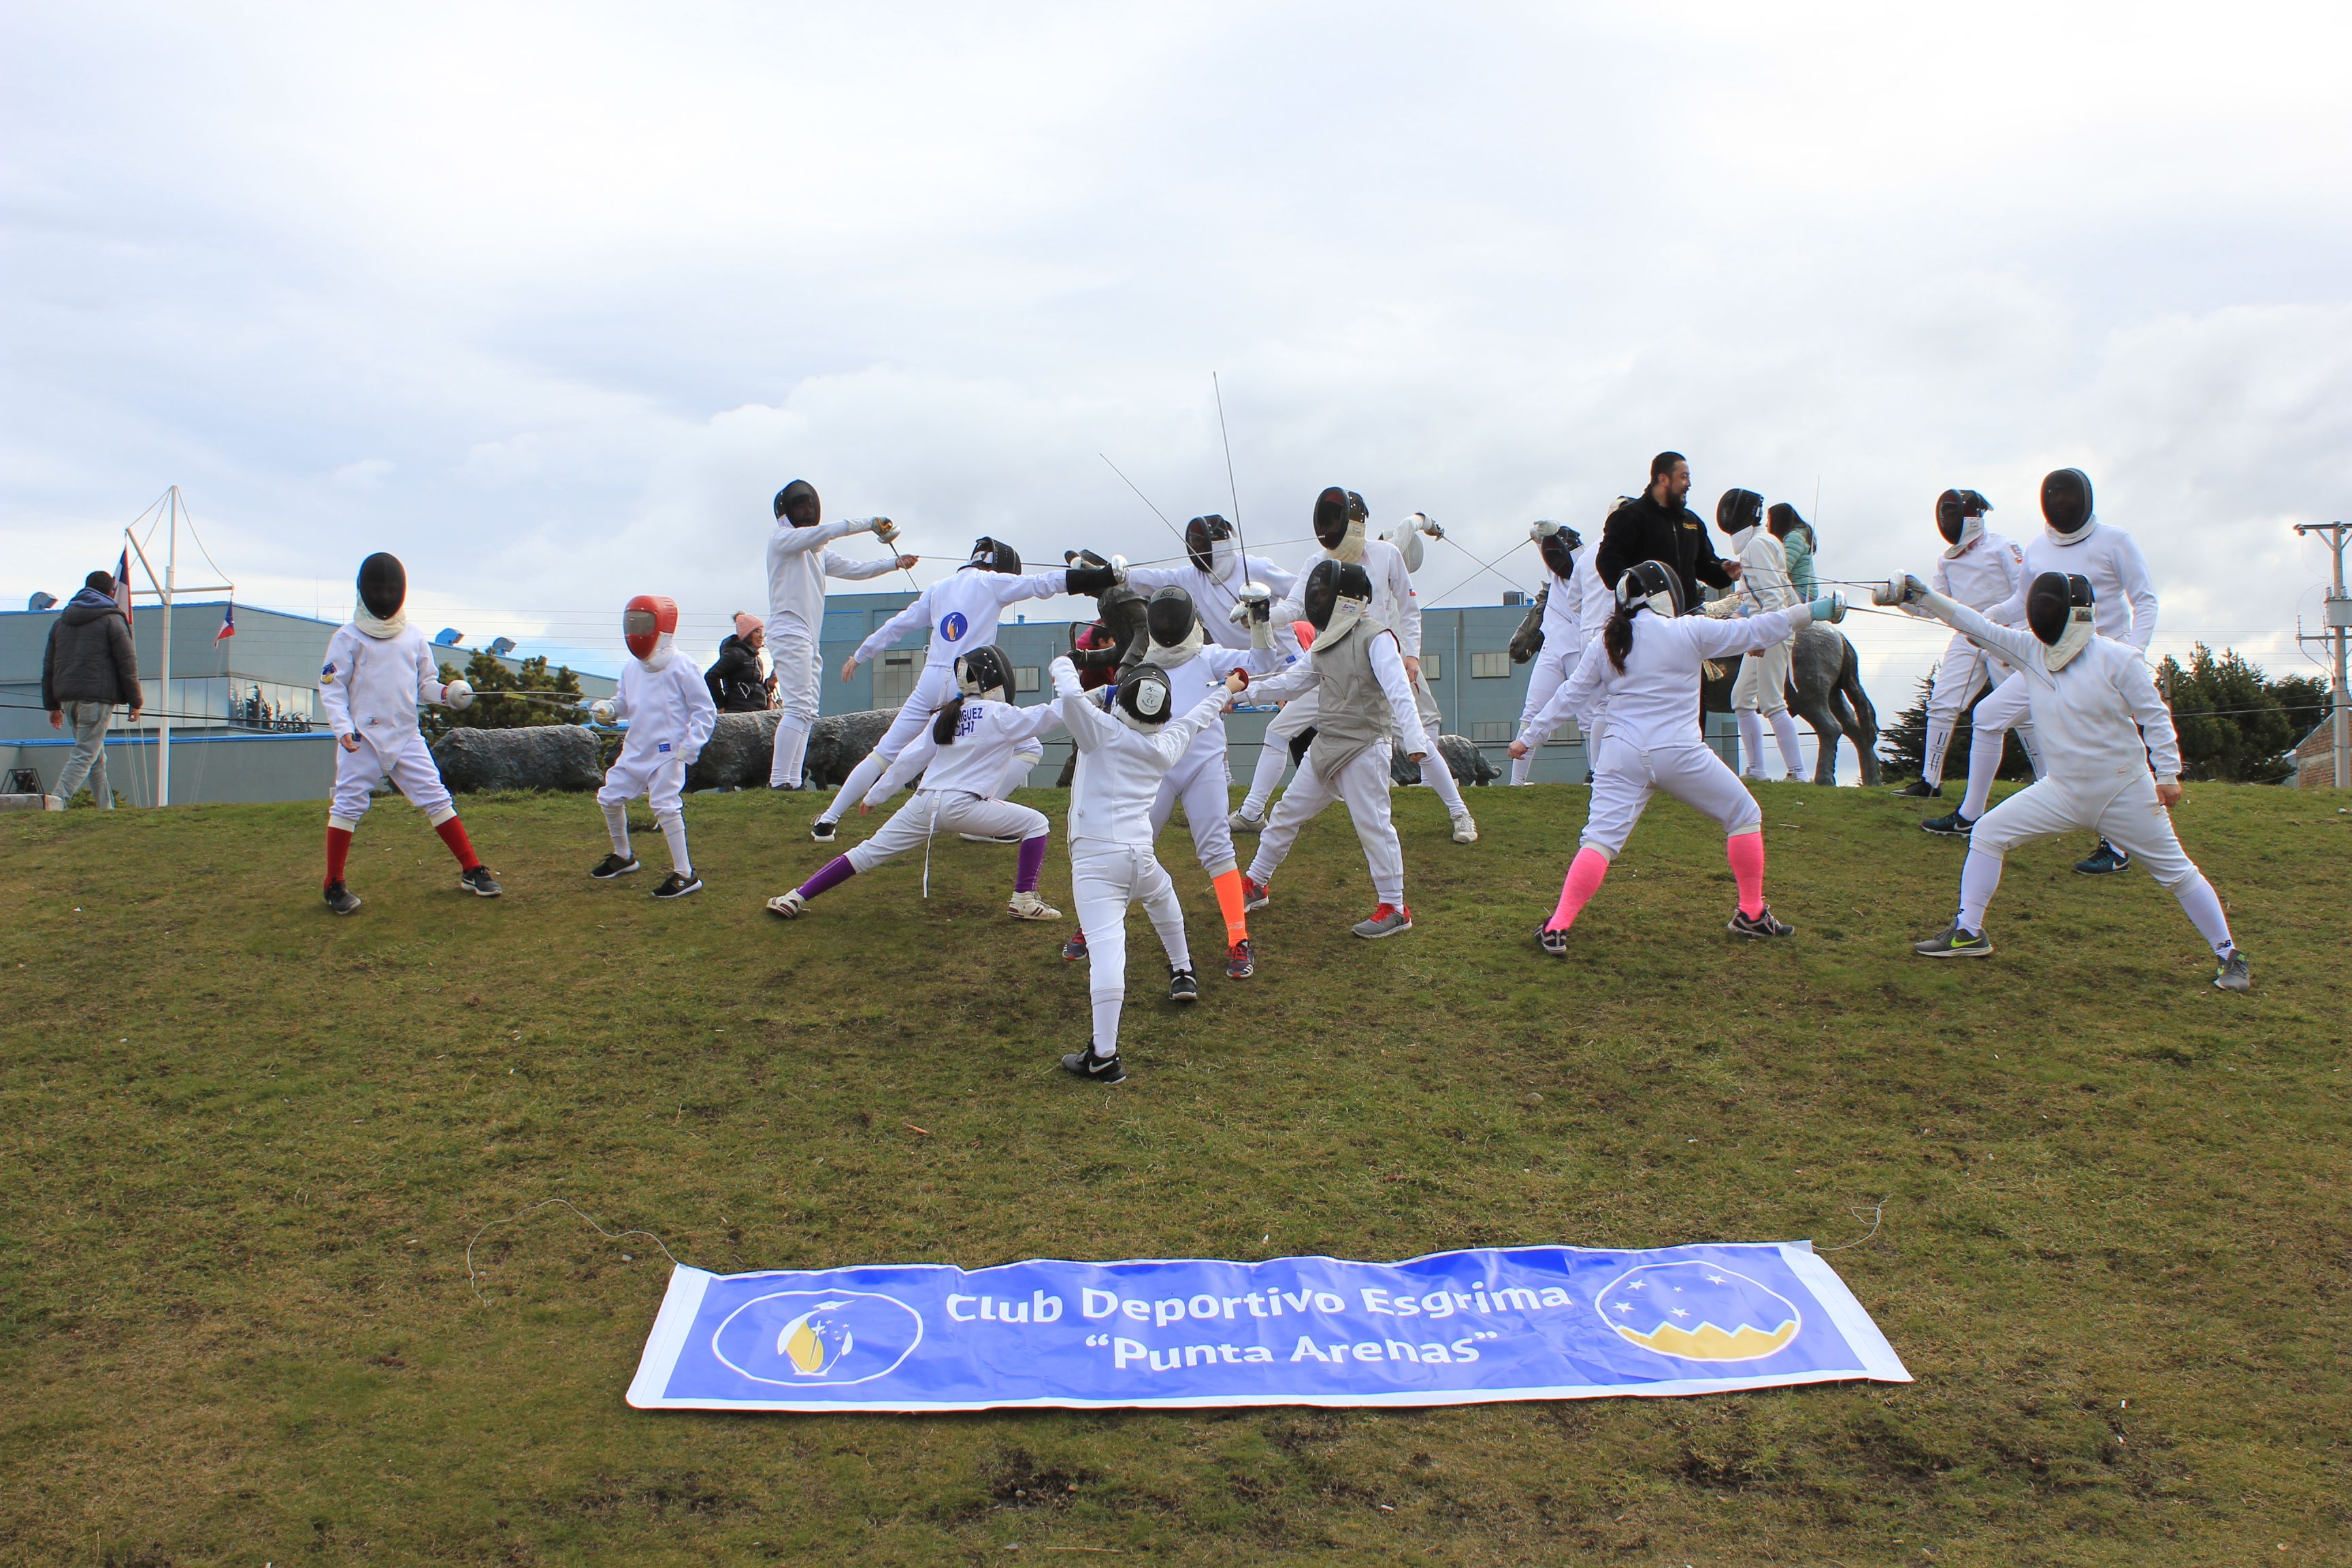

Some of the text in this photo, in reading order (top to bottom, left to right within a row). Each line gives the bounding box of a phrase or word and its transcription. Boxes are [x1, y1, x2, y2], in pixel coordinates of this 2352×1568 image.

[958, 707, 983, 723] IGUEZ
[946, 1281, 1573, 1327] Club Deportivo Esgrima
[1085, 1330, 1498, 1371] “Punta Arenas”
